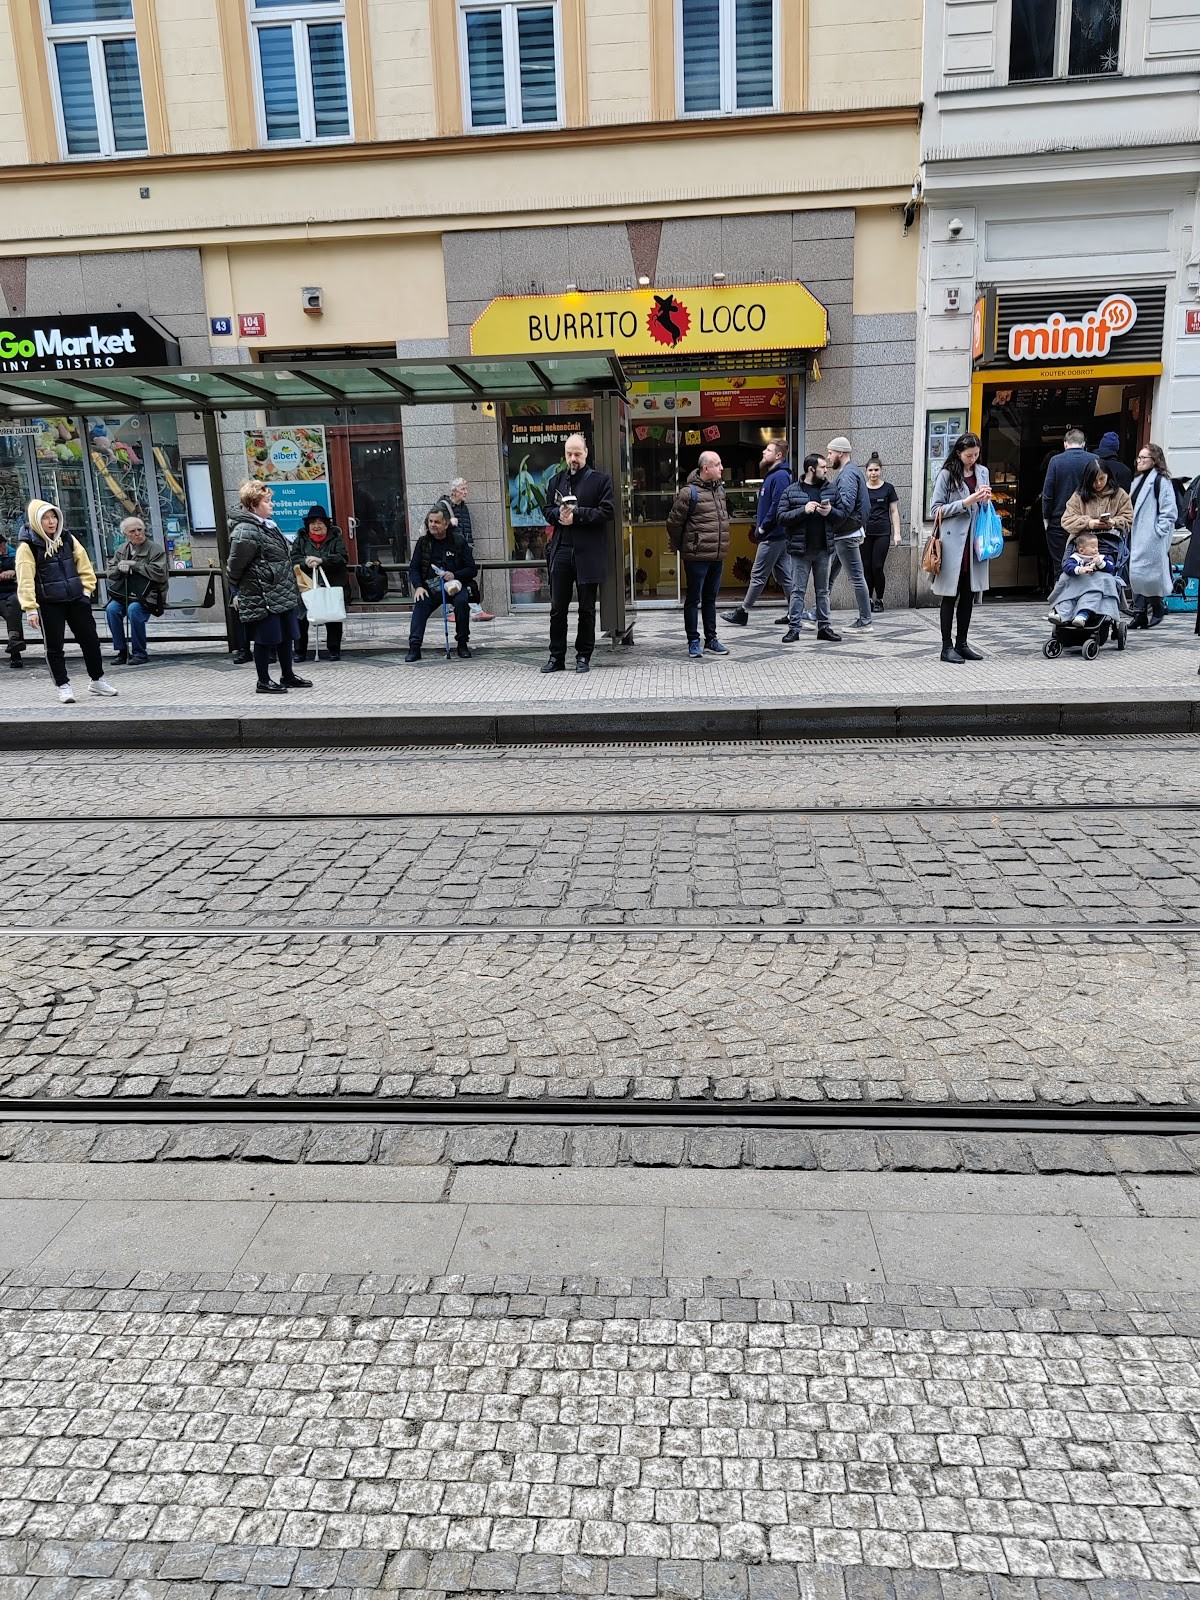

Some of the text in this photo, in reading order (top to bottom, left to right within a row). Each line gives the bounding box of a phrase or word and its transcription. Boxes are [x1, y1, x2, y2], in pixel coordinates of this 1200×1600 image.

[215, 321, 227, 331] 43
[243, 316, 259, 327] 104
[529, 304, 766, 341] BURRITO LOCO
[1013, 316, 1111, 356] minit
[56, 357, 115, 369] BISTRO
[511, 421, 581, 433] Zima není nekonečná!
[512, 433, 529, 444] Jarní
[530, 433, 558, 445] projekty
[273, 451, 298, 460] albert
